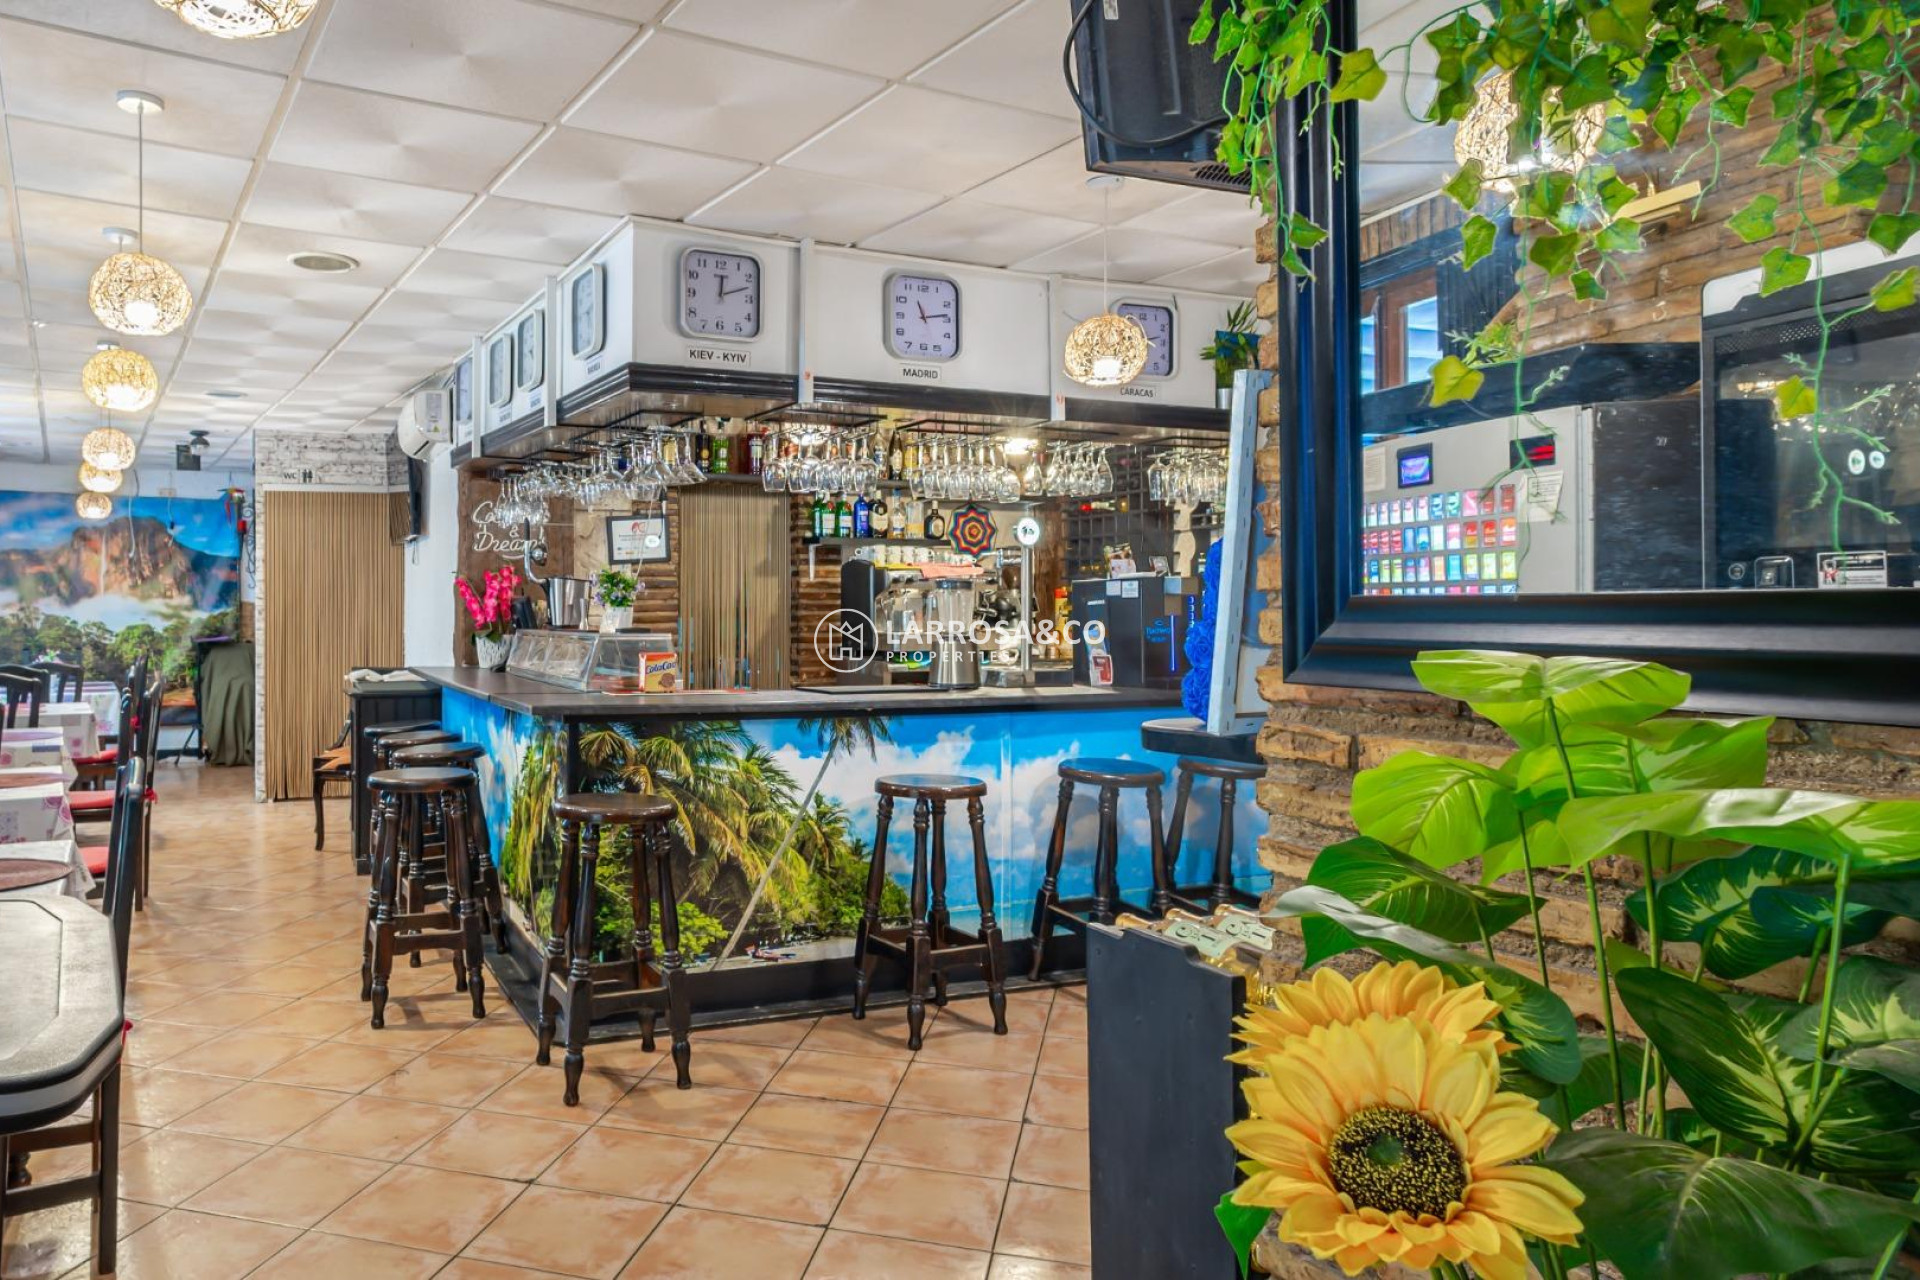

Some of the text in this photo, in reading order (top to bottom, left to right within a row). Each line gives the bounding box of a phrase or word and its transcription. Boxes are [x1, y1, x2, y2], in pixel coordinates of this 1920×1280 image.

[698, 259, 707, 268] 11
[716, 260, 727, 270] 12
[689, 270, 699, 280] 10
[745, 273, 753, 283] 2
[688, 287, 696, 298] 9
[917, 285, 929, 293] 12
[745, 294, 753, 304] 3
[896, 296, 907, 304] 10
[688, 306, 697, 318] 8
[744, 313, 752, 322] 4
[700, 319, 742, 333] 7 6 5
[896, 328, 905, 336] 8
[904, 341, 942, 352] 7 6 5
[689, 349, 714, 360] KIEV
[723, 352, 747, 363] KYIV
[903, 369, 939, 379] MADRID
[1121, 387, 1153, 397] CARACAS
